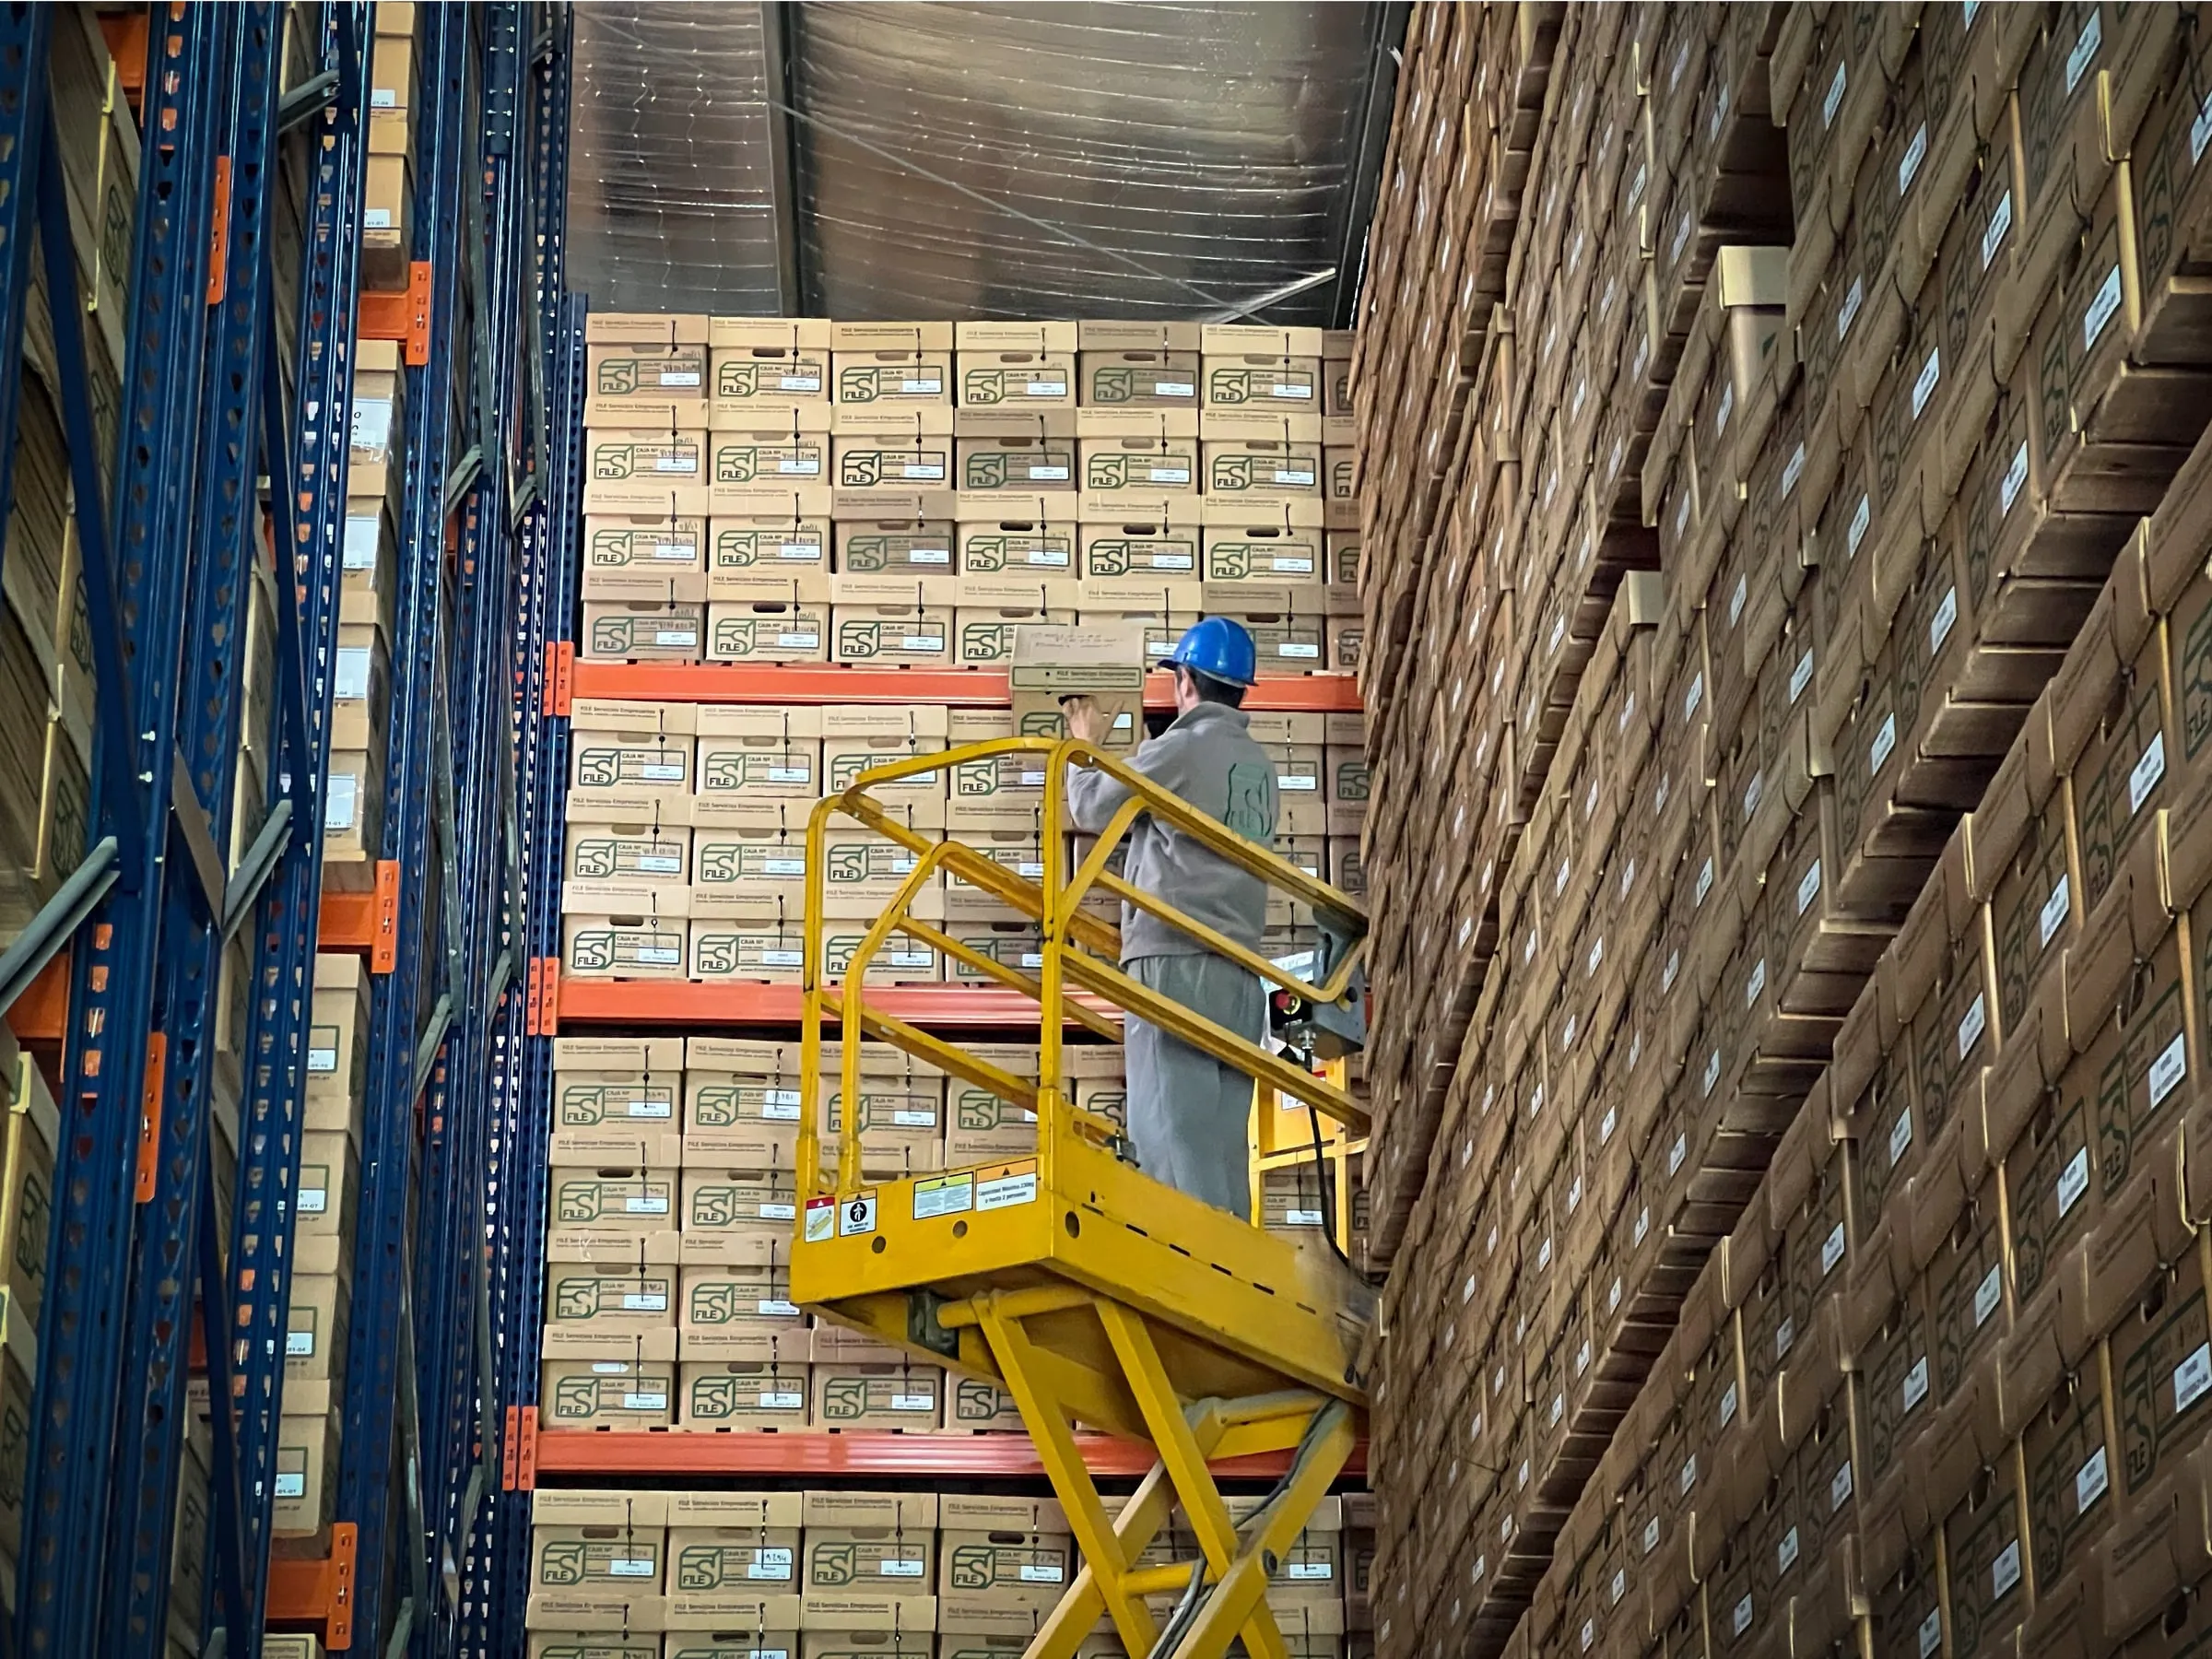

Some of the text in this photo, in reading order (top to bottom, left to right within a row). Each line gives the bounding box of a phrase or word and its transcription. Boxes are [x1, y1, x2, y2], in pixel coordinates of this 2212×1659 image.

[602, 382, 622, 391] FILE
[723, 385, 743, 394] FILE
[844, 391, 865, 399] FILE
[970, 391, 990, 401] FILE
[1215, 392, 1235, 401] FILE
[598, 468, 618, 477] FILE
[721, 470, 742, 479] FILE
[846, 474, 866, 484] FILE
[971, 477, 991, 485] FILE
[1092, 477, 1112, 486] FILE
[1217, 477, 1238, 487] FILE
[596, 554, 617, 562] FILE
[722, 555, 742, 564] FILE
[851, 559, 871, 568] FILE
[970, 559, 990, 568] FILE
[1094, 563, 1115, 572] FILE
[1215, 567, 1236, 576] FILE
[596, 641, 617, 650] FILE
[720, 643, 739, 652] FILE
[844, 645, 865, 655] FILE
[968, 647, 989, 657] FILE
[2188, 698, 2207, 738] FILE
[583, 773, 605, 782] FILE
[710, 777, 730, 786] FILE
[962, 782, 983, 792] FILE
[579, 865, 600, 874] FILE
[705, 869, 726, 878] FILE
[833, 870, 853, 879] FILE
[577, 957, 598, 966] FILE
[701, 960, 724, 970] FILE
[567, 1112, 588, 1122] FILE
[700, 1112, 721, 1122] FILE
[962, 1118, 983, 1126] FILE
[2103, 1147, 2123, 1179] FILE
[563, 1209, 584, 1218] FILE
[697, 1212, 718, 1221] FILE
[695, 1310, 717, 1319] FILE
[559, 1406, 582, 1414] FILE
[697, 1405, 718, 1414] FILE
[829, 1406, 849, 1415] FILE
[961, 1406, 982, 1416] FILE
[546, 1571, 568, 1581] FILE
[683, 1575, 705, 1584] FILE
[817, 1571, 839, 1581] FILE
[956, 1574, 978, 1583] FILE
